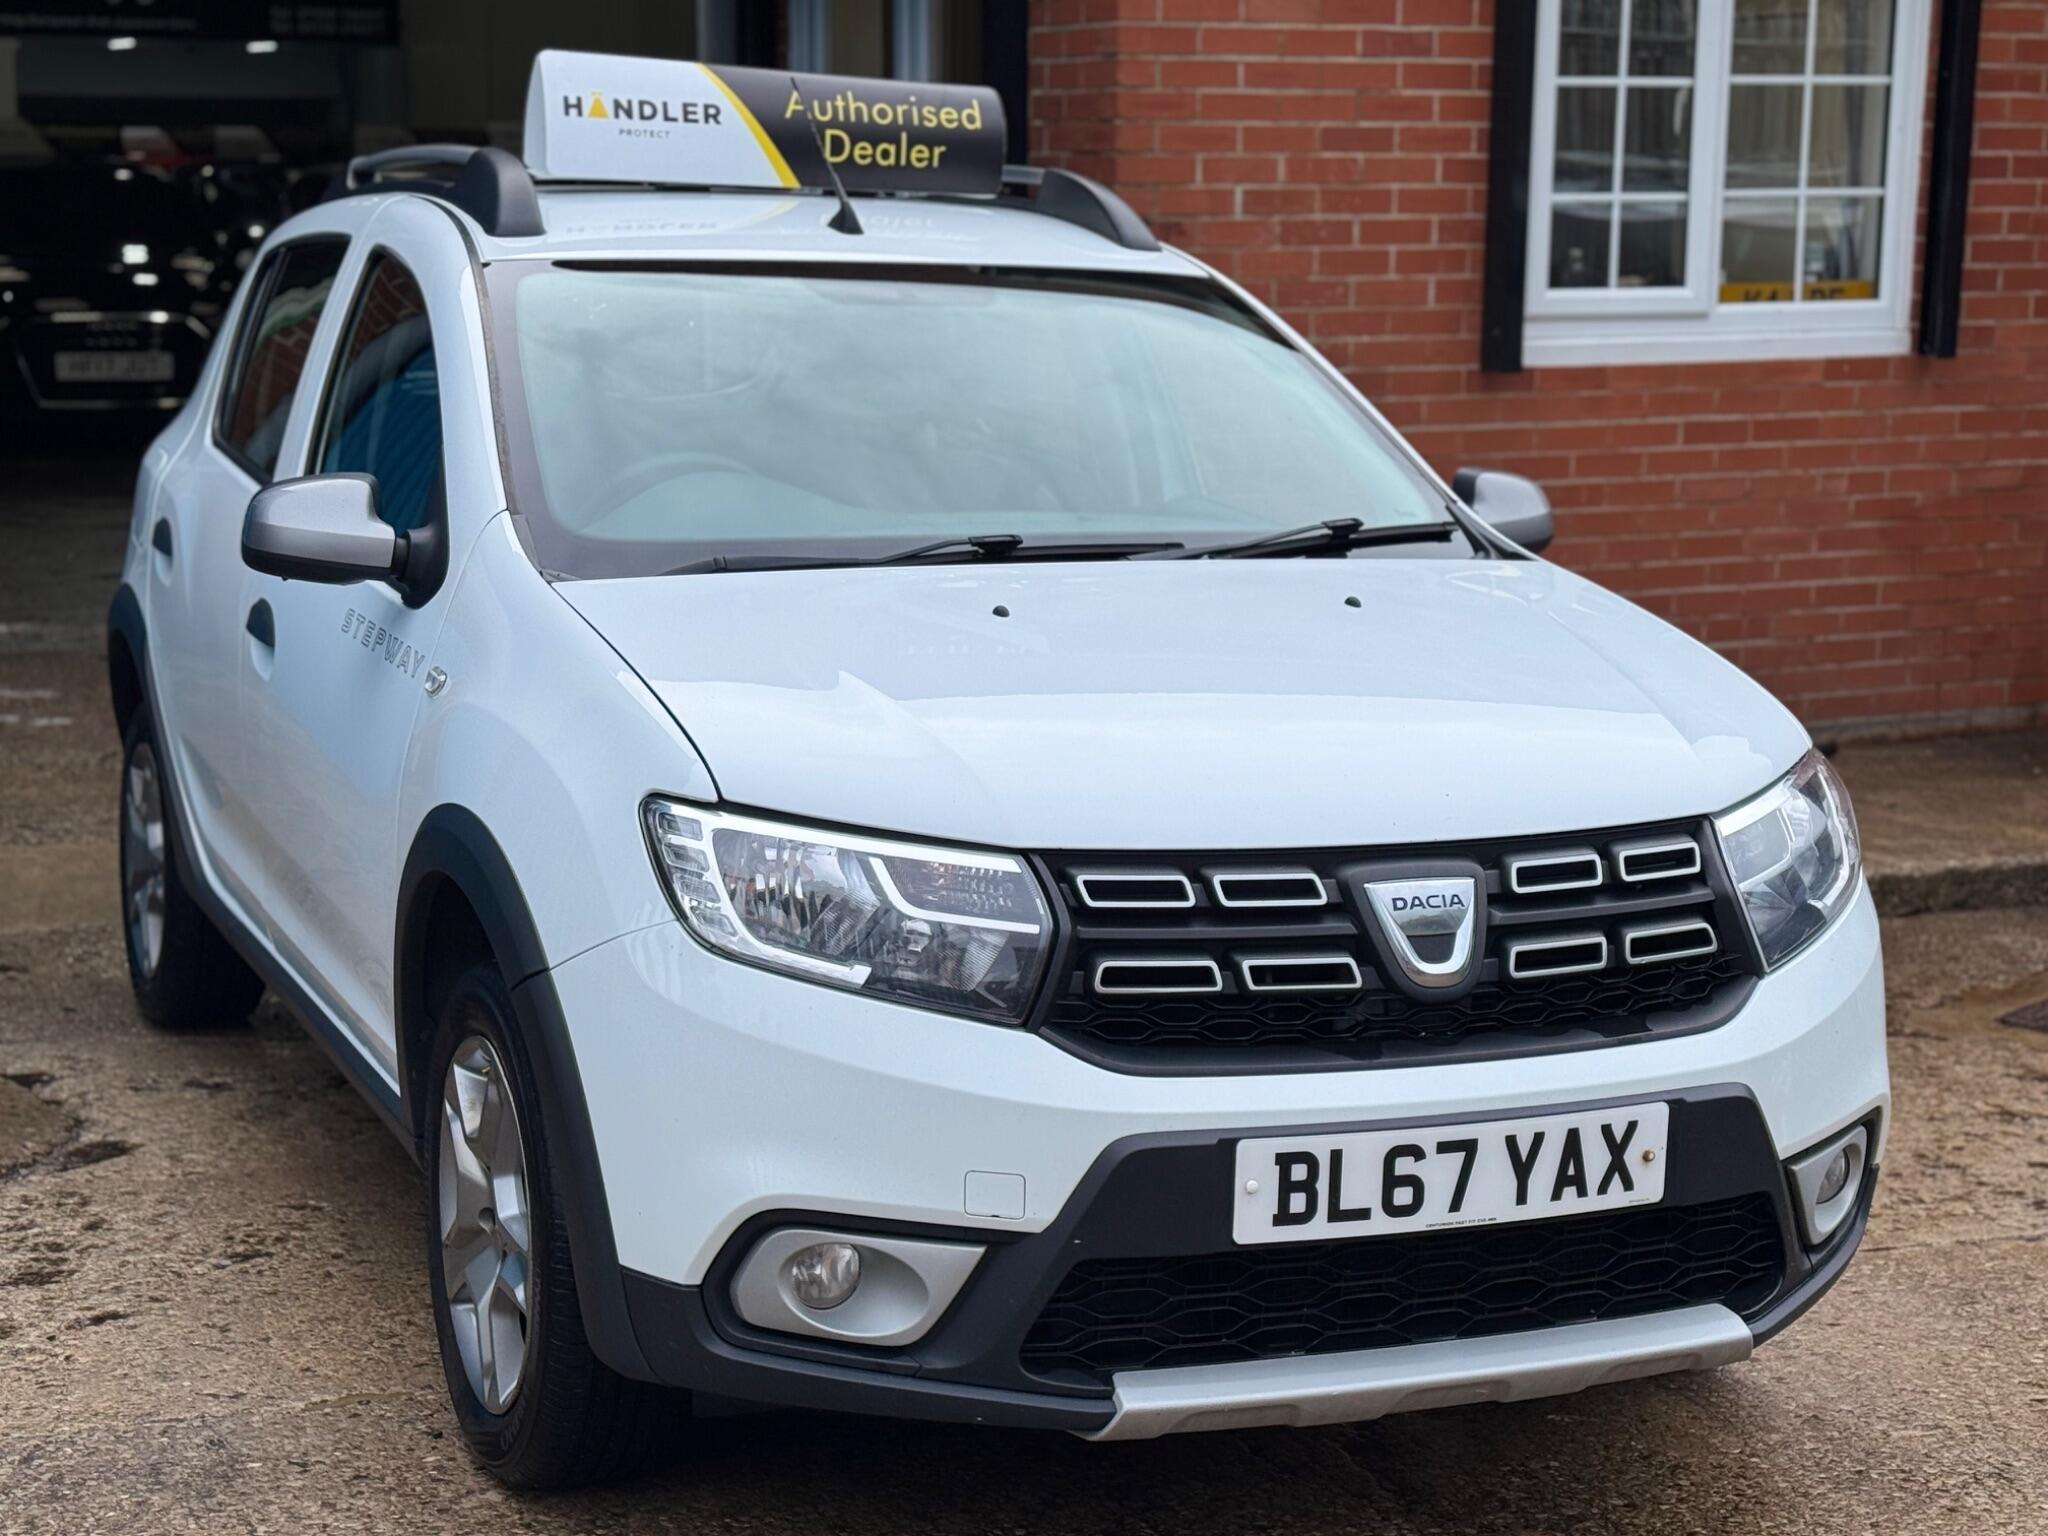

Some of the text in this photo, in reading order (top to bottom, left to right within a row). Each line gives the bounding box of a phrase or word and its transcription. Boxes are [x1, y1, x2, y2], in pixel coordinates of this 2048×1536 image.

[784, 90, 982, 130] Authorised
[618, 128, 670, 139] PROTECT
[824, 128, 946, 168] Dealer
[341, 608, 426, 678] STEPWAY
[1391, 894, 1465, 911] DACIA
[1272, 1120, 1639, 1227] BL67 YAX
